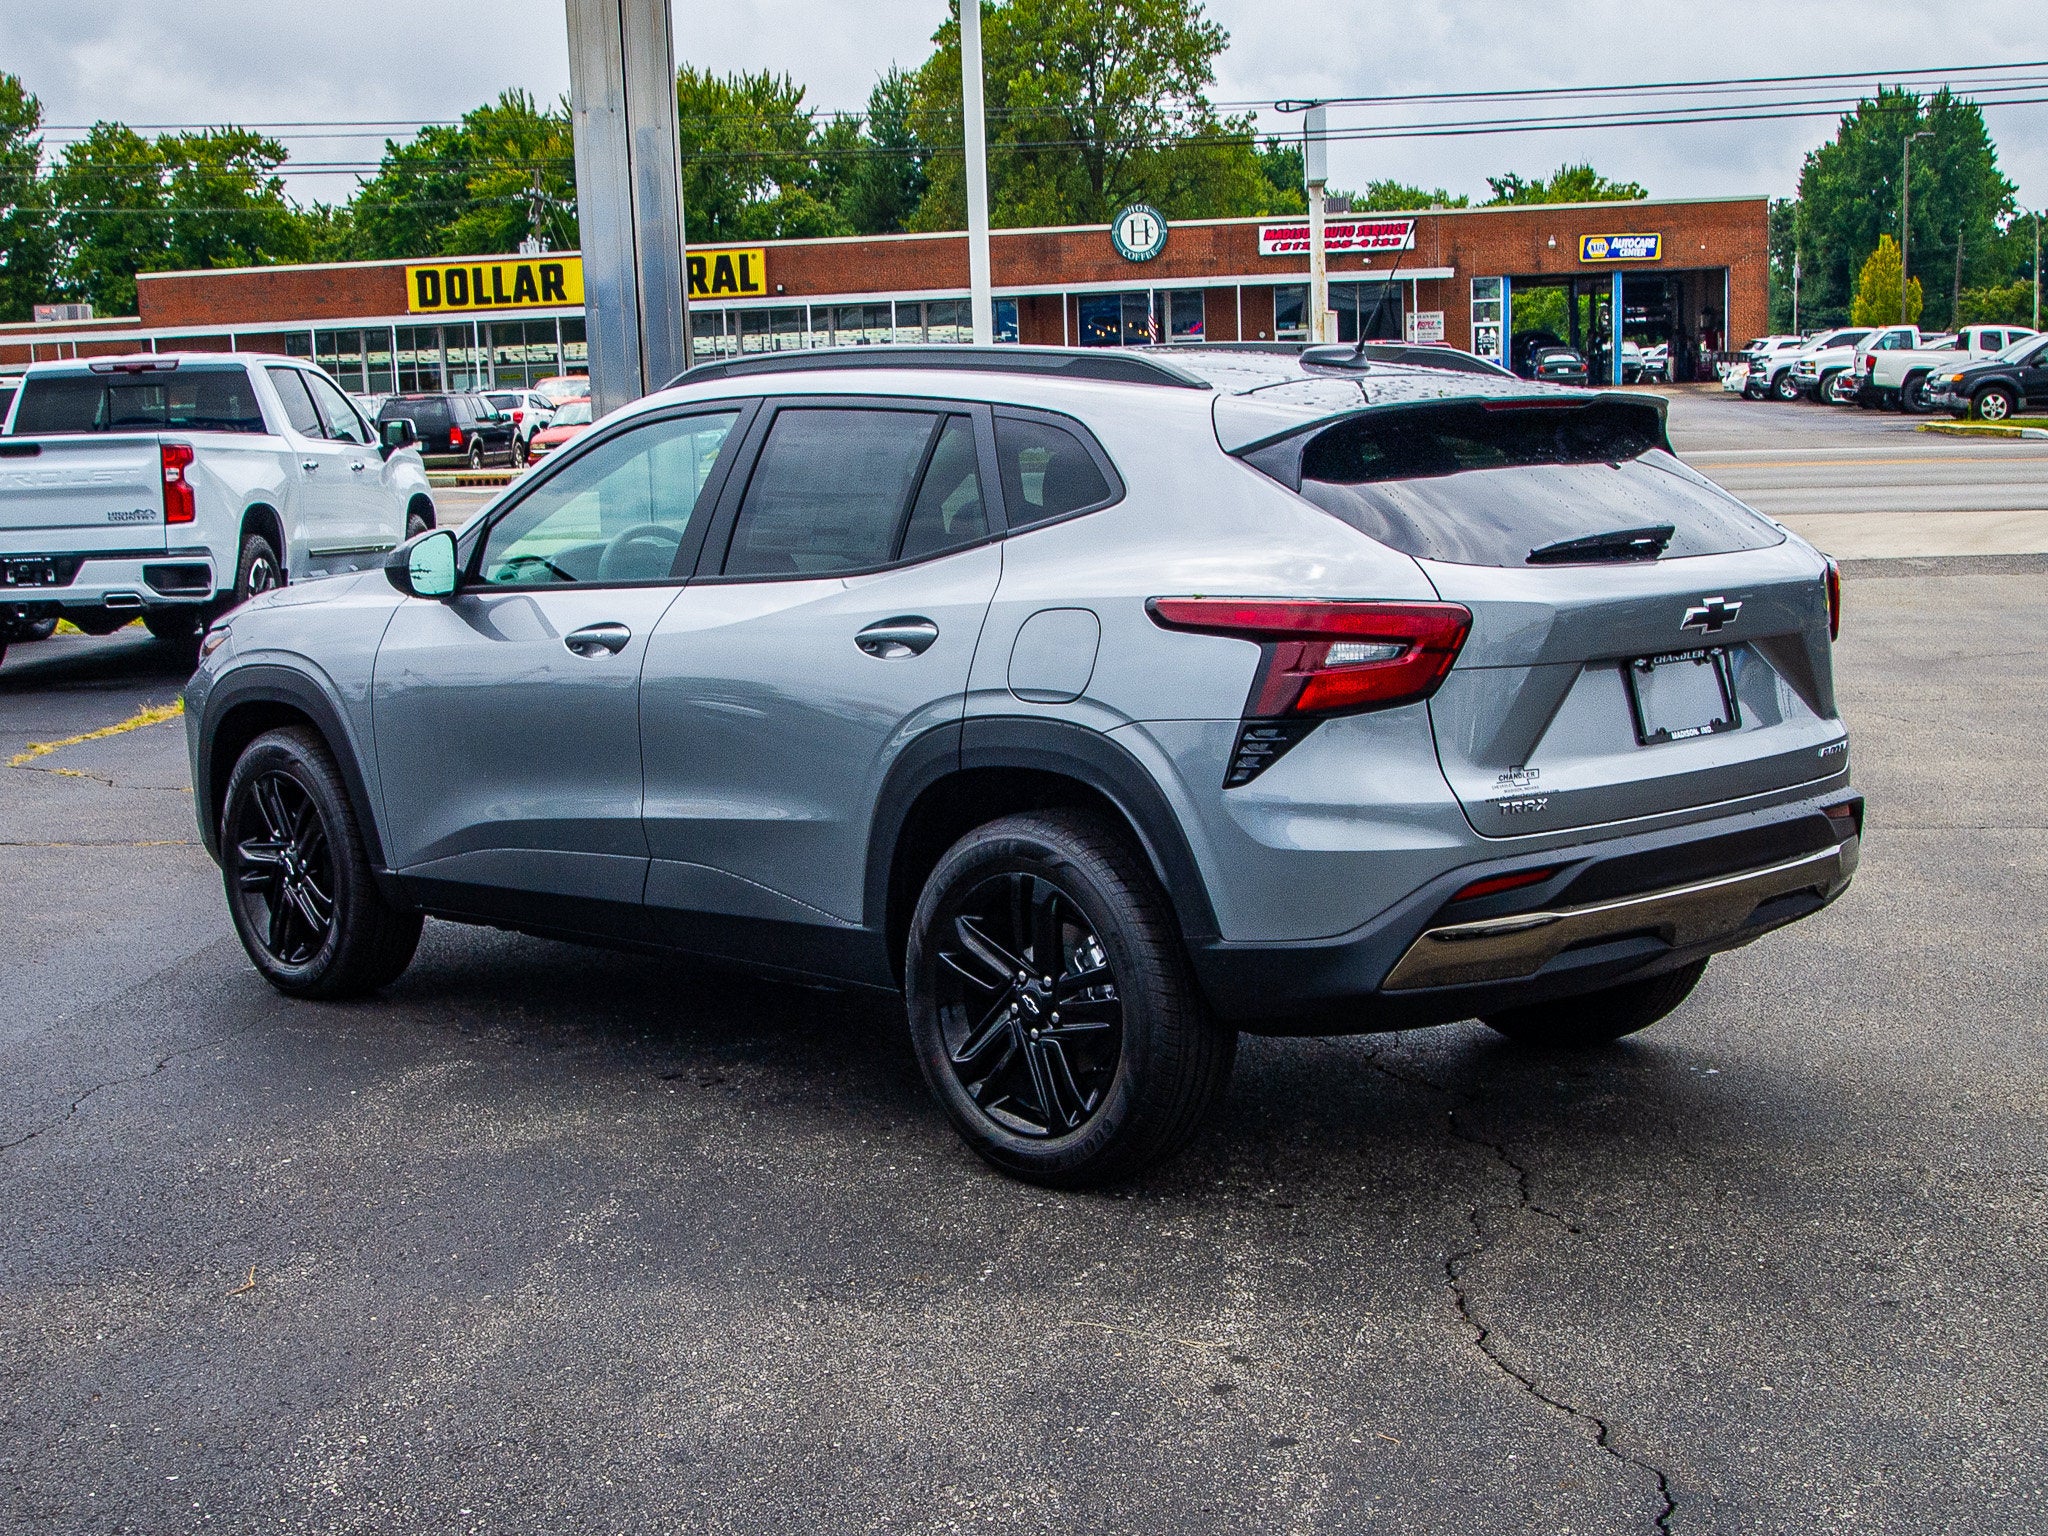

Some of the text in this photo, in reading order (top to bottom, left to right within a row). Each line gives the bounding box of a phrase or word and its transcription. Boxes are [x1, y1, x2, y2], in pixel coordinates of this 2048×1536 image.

[1264, 227, 1310, 240] MADISO
[1356, 223, 1409, 237] SERVICE
[1620, 248, 1646, 256] CENTER
[415, 254, 758, 307] DOLLAR RAL
[1653, 650, 1705, 663] CHANDLER
[1498, 771, 1536, 782] CHANDLER
[1499, 797, 1548, 815] TRAX
